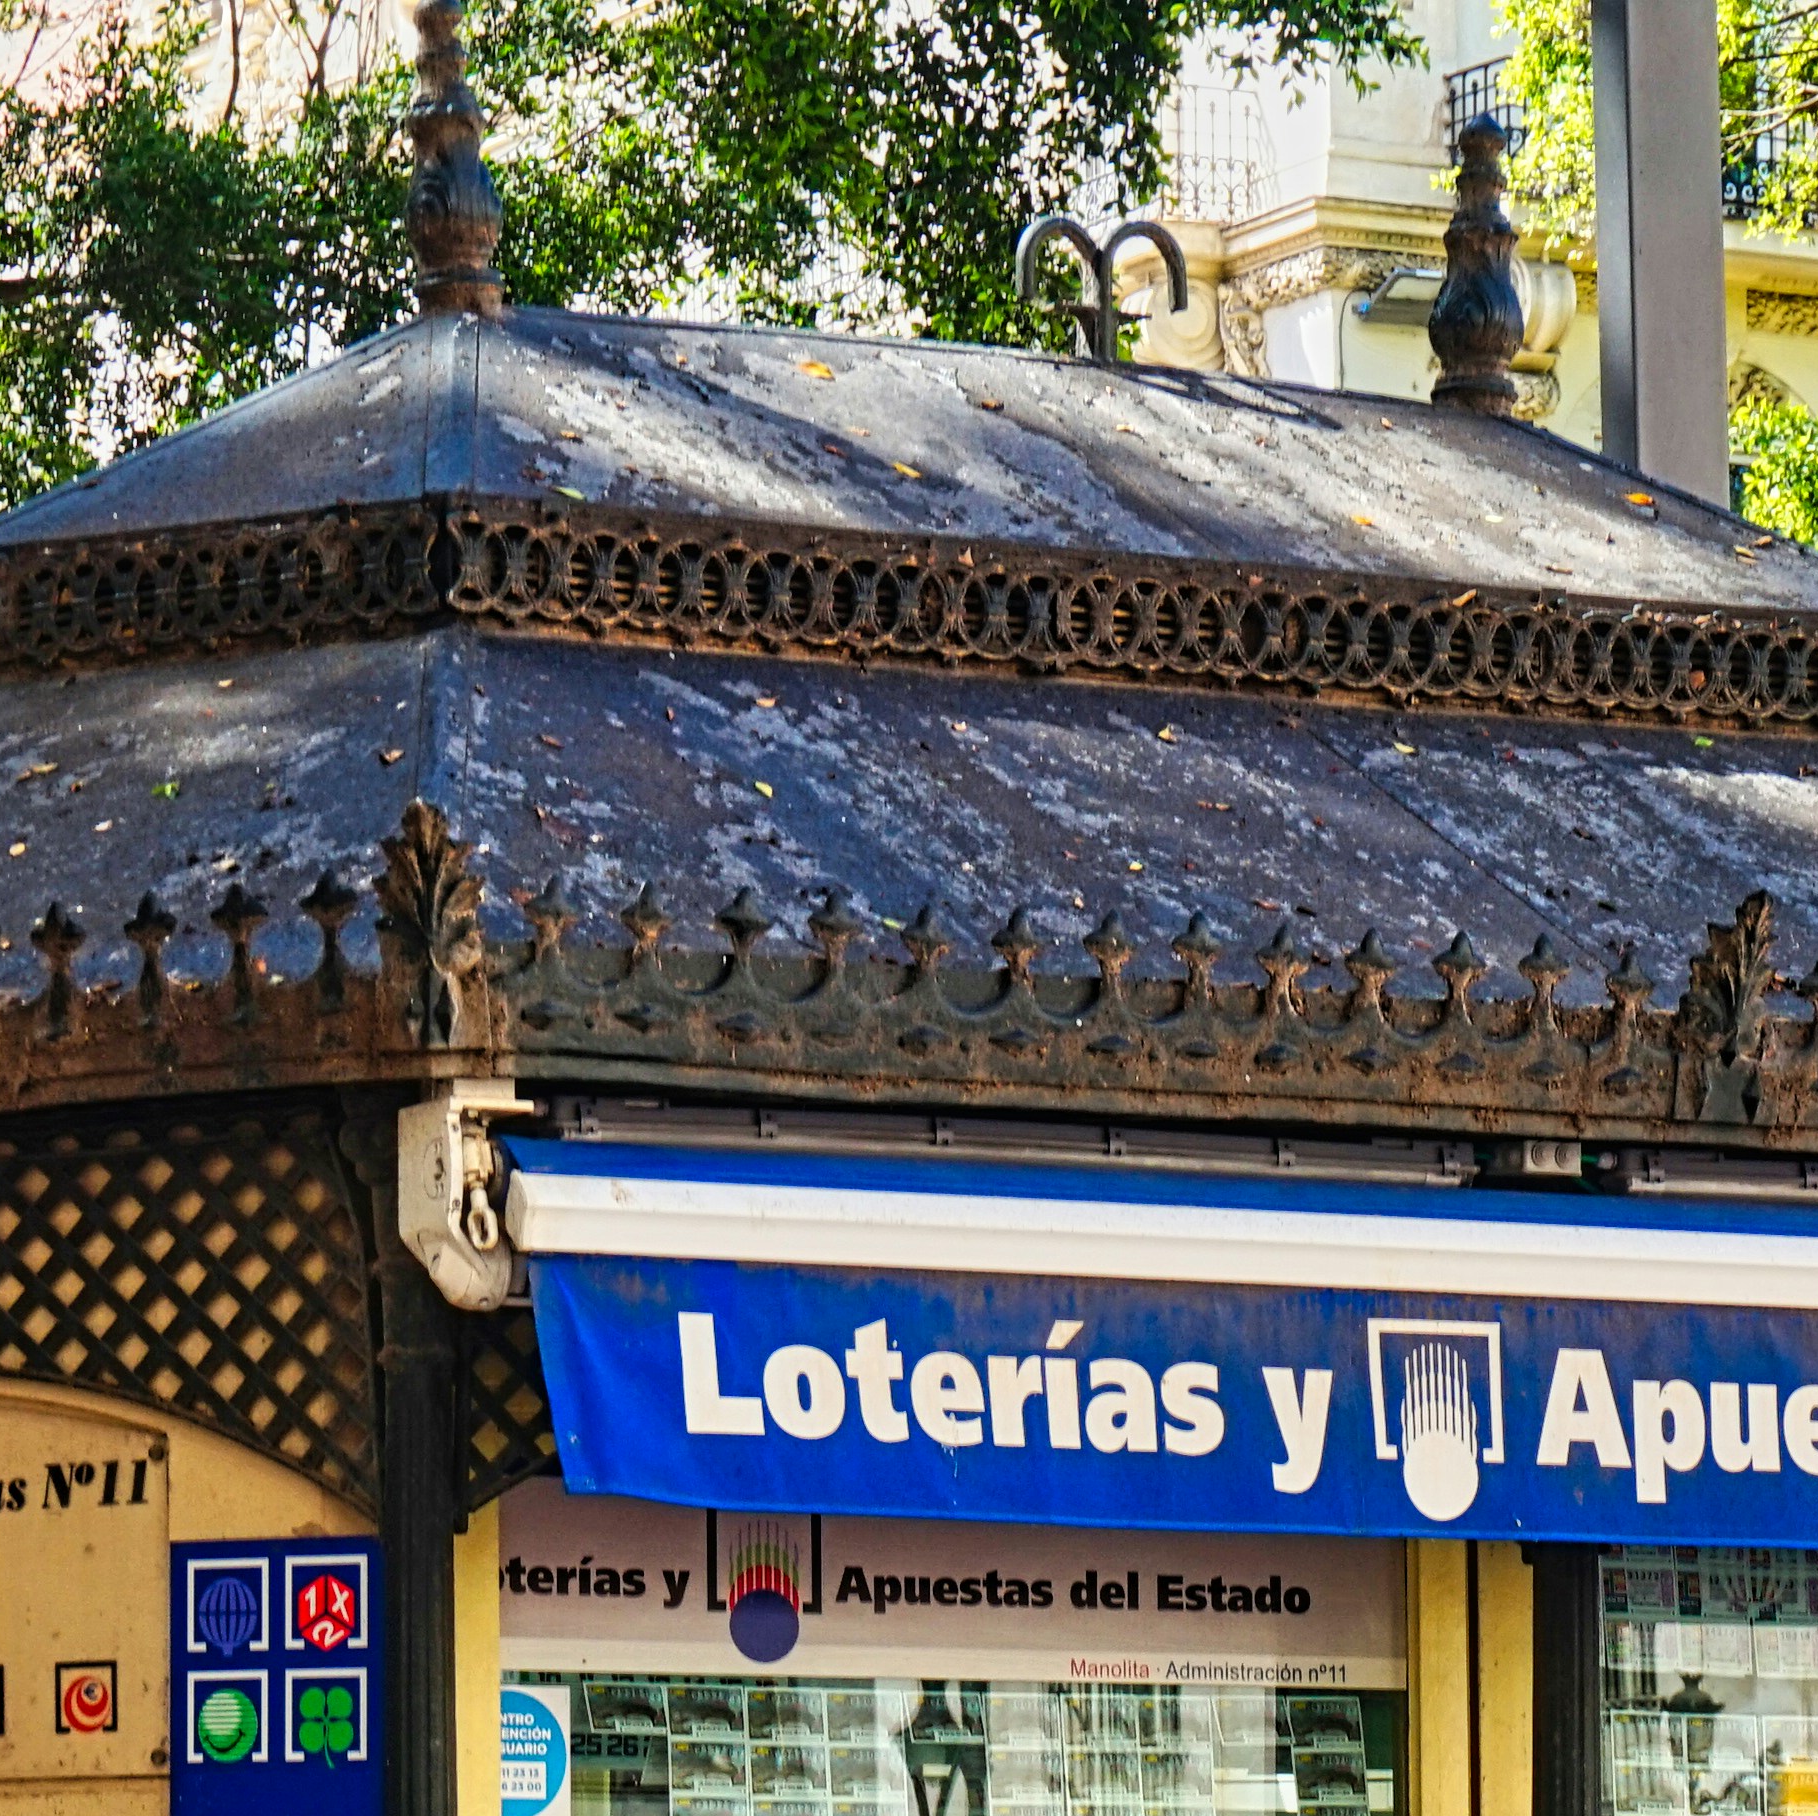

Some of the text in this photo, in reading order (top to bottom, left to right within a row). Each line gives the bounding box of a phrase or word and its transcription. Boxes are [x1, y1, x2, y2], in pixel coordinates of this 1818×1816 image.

[677, 1310, 1225, 1458] Loterías
[1263, 1367, 1333, 1494] y
[499, 1556, 1312, 1615] terías y Apuestas del Estado
[1070, 1658, 1150, 1680] Manolita
[1165, 1661, 1303, 1684] Administración
[607, 1734, 639, 1756] 26
